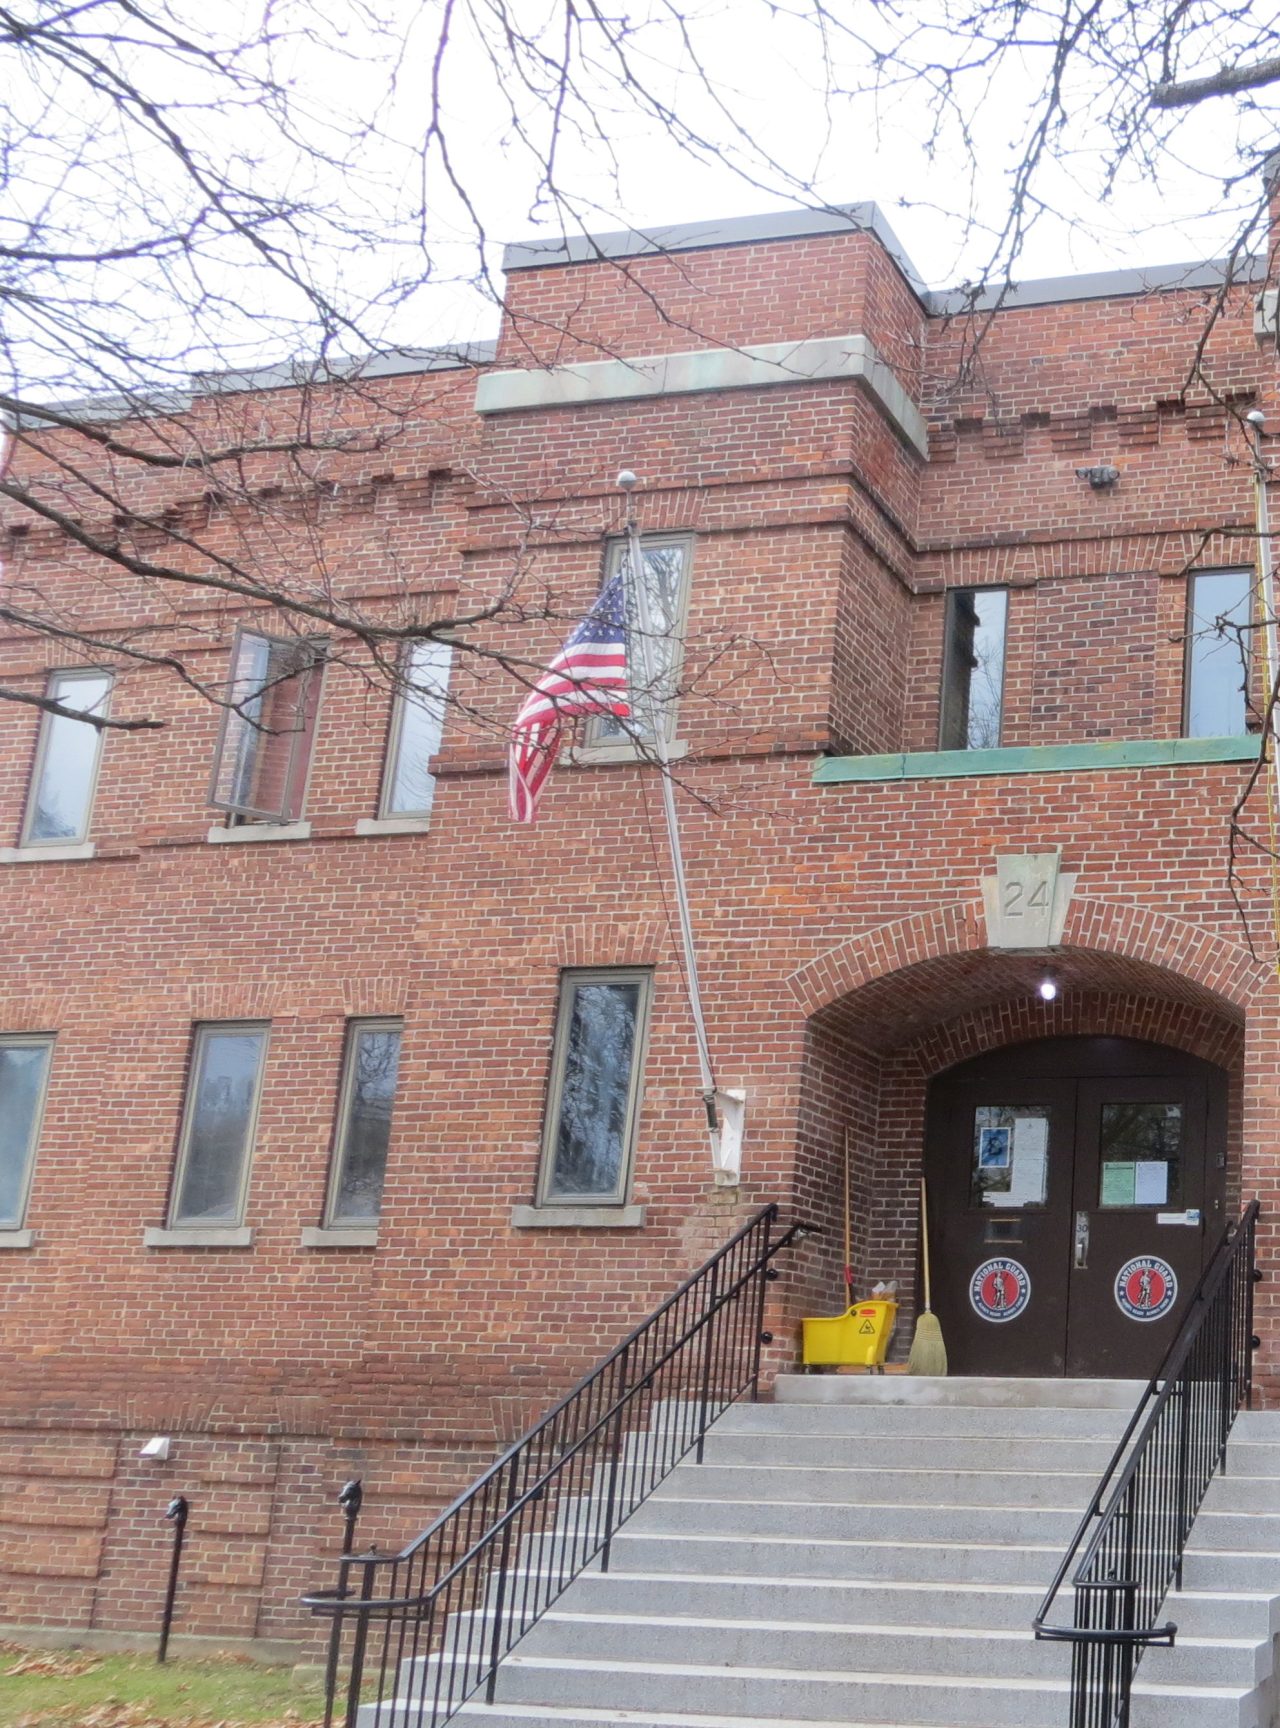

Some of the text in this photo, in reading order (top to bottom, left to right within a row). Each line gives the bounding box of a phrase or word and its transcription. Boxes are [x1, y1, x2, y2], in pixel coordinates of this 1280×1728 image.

[1004, 881, 1049, 917] 24
[974, 1262, 1026, 1292] NATIONAL GUARD
[1119, 1260, 1173, 1288] NATIONAL GUARD
